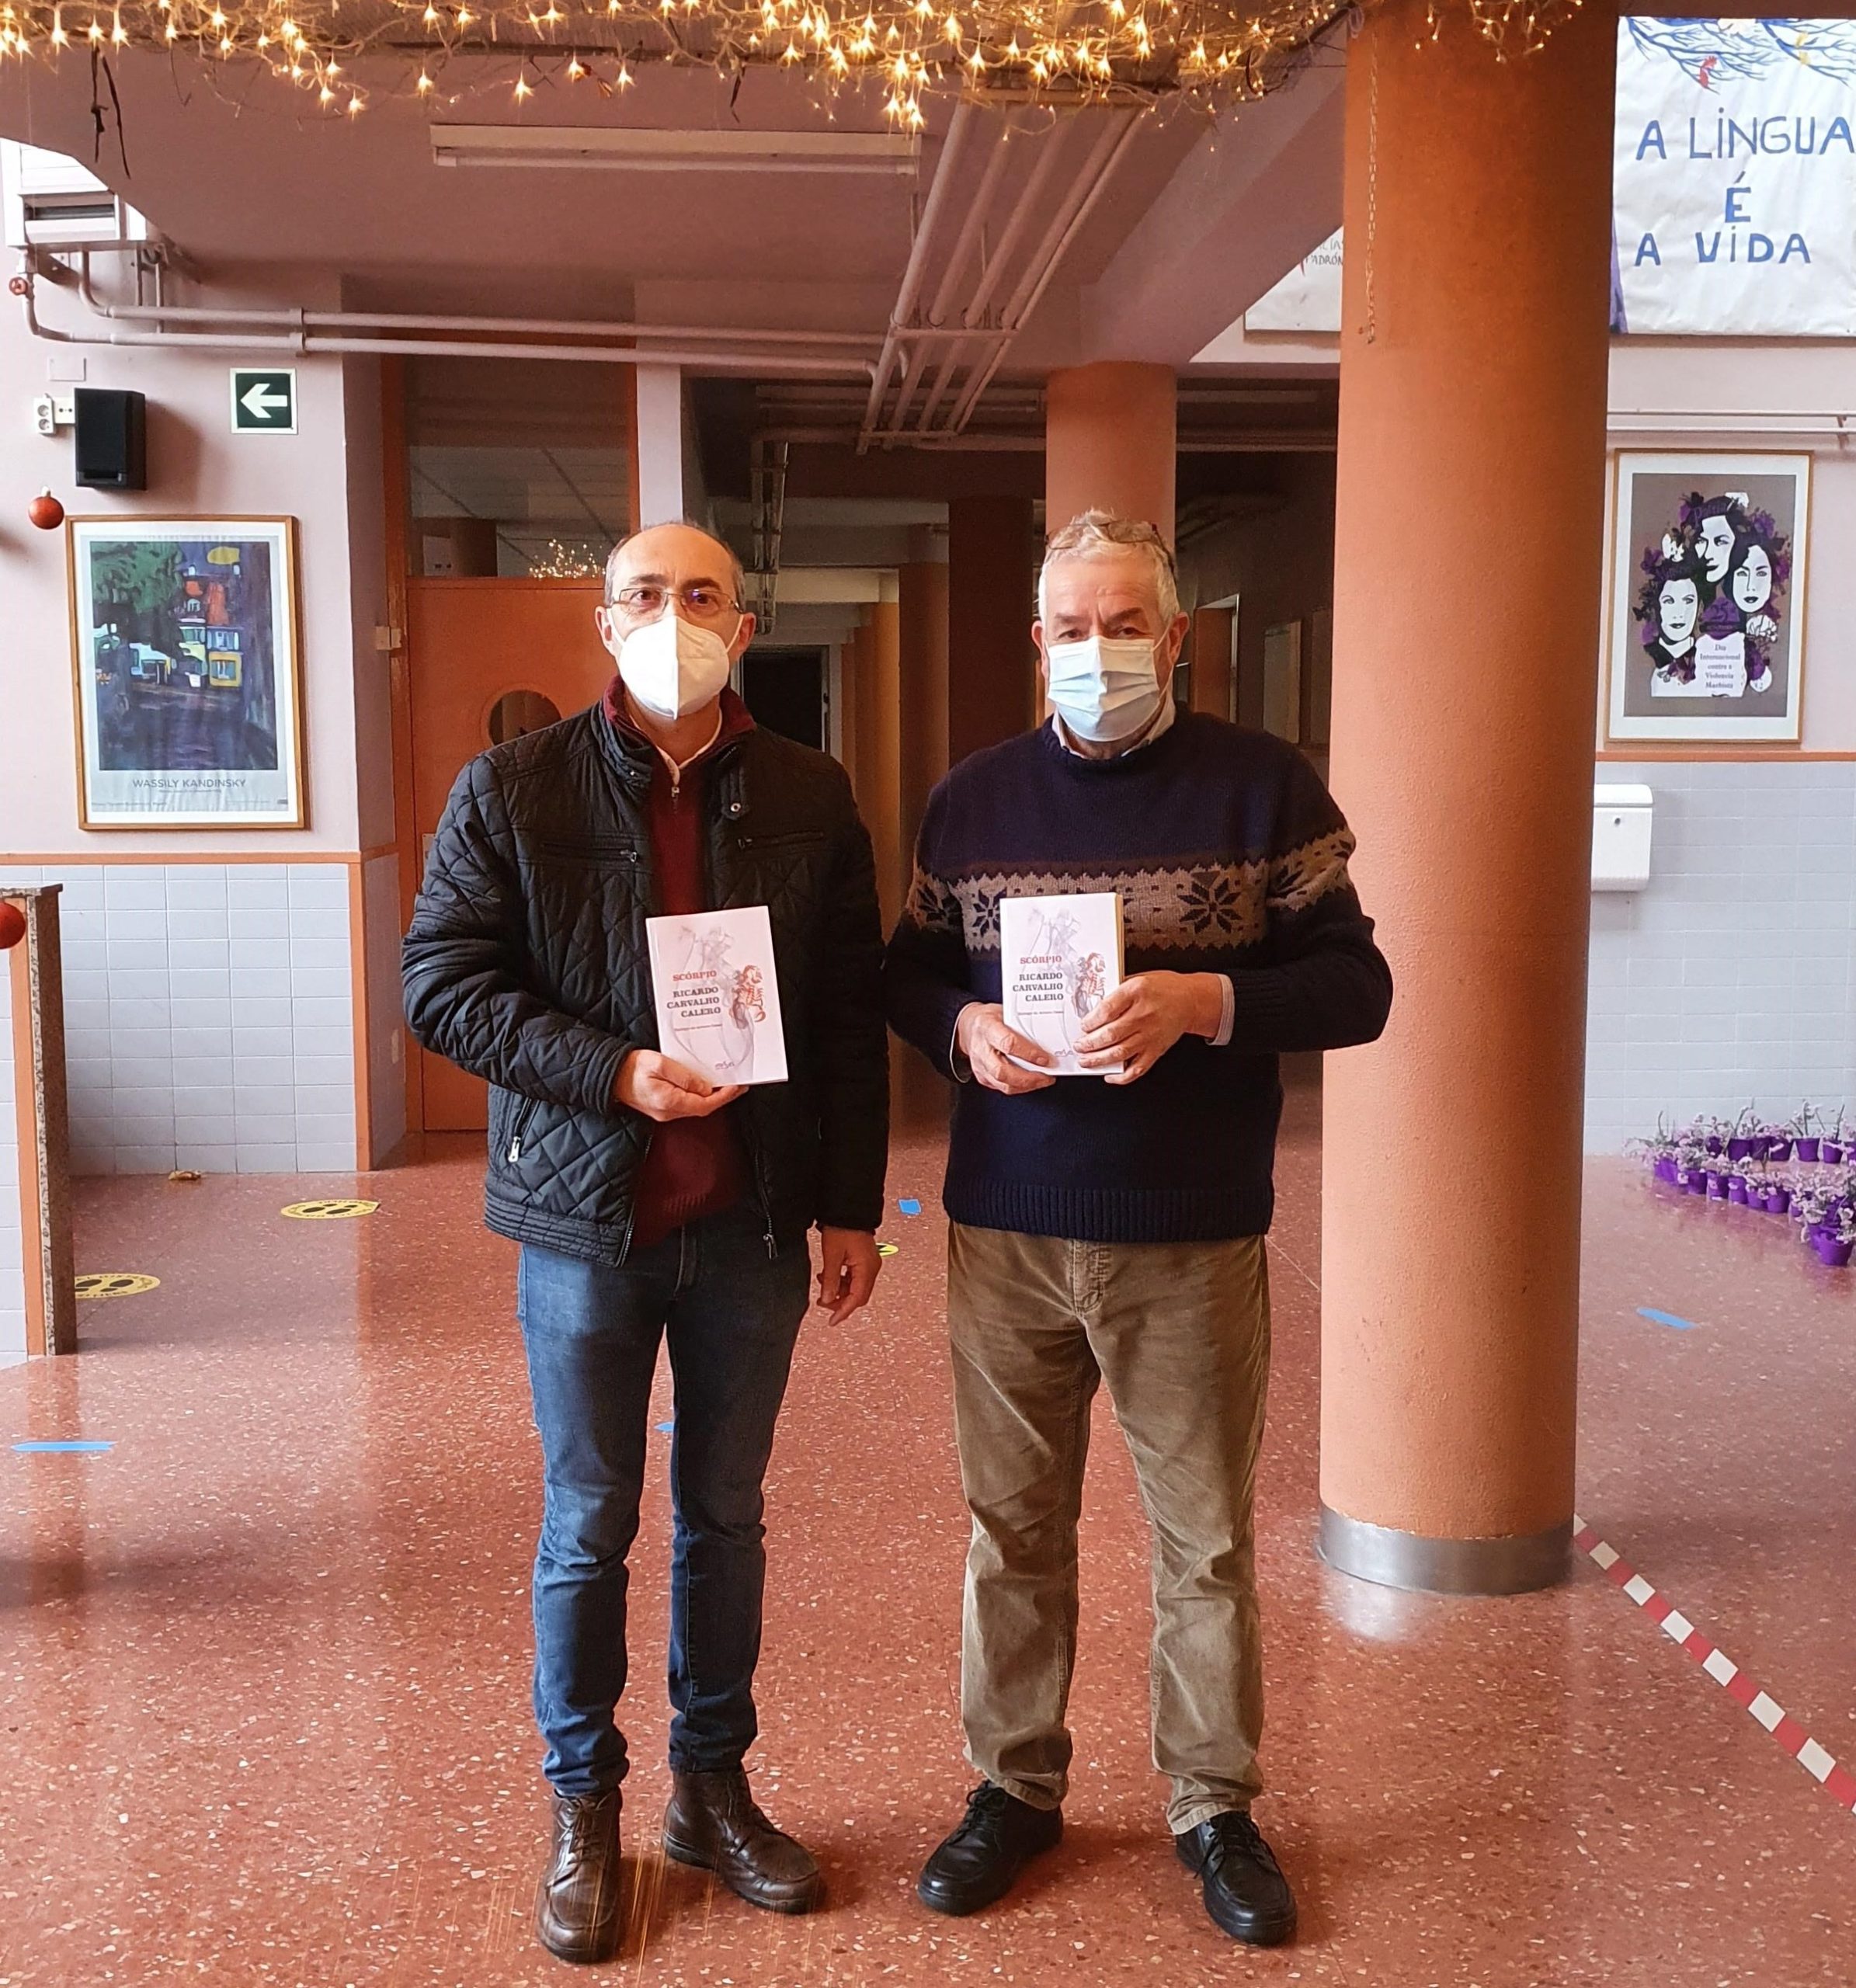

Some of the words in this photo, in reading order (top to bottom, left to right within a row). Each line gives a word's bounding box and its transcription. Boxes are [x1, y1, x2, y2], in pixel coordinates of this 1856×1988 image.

[1635, 120, 1667, 160] A
[1724, 171, 1751, 223] É
[1635, 232, 1661, 266] A
[133, 779, 179, 787] WASSILY
[182, 779, 245, 787] KANDINSKY
[1019, 972, 1063, 981] RICARDO
[673, 986, 719, 998] RICARDO
[1012, 982, 1063, 992] CARVALHO
[666, 996, 720, 1009] CARVALHO
[1025, 993, 1064, 1002] CALERO
[681, 1006, 721, 1017] CALERO
